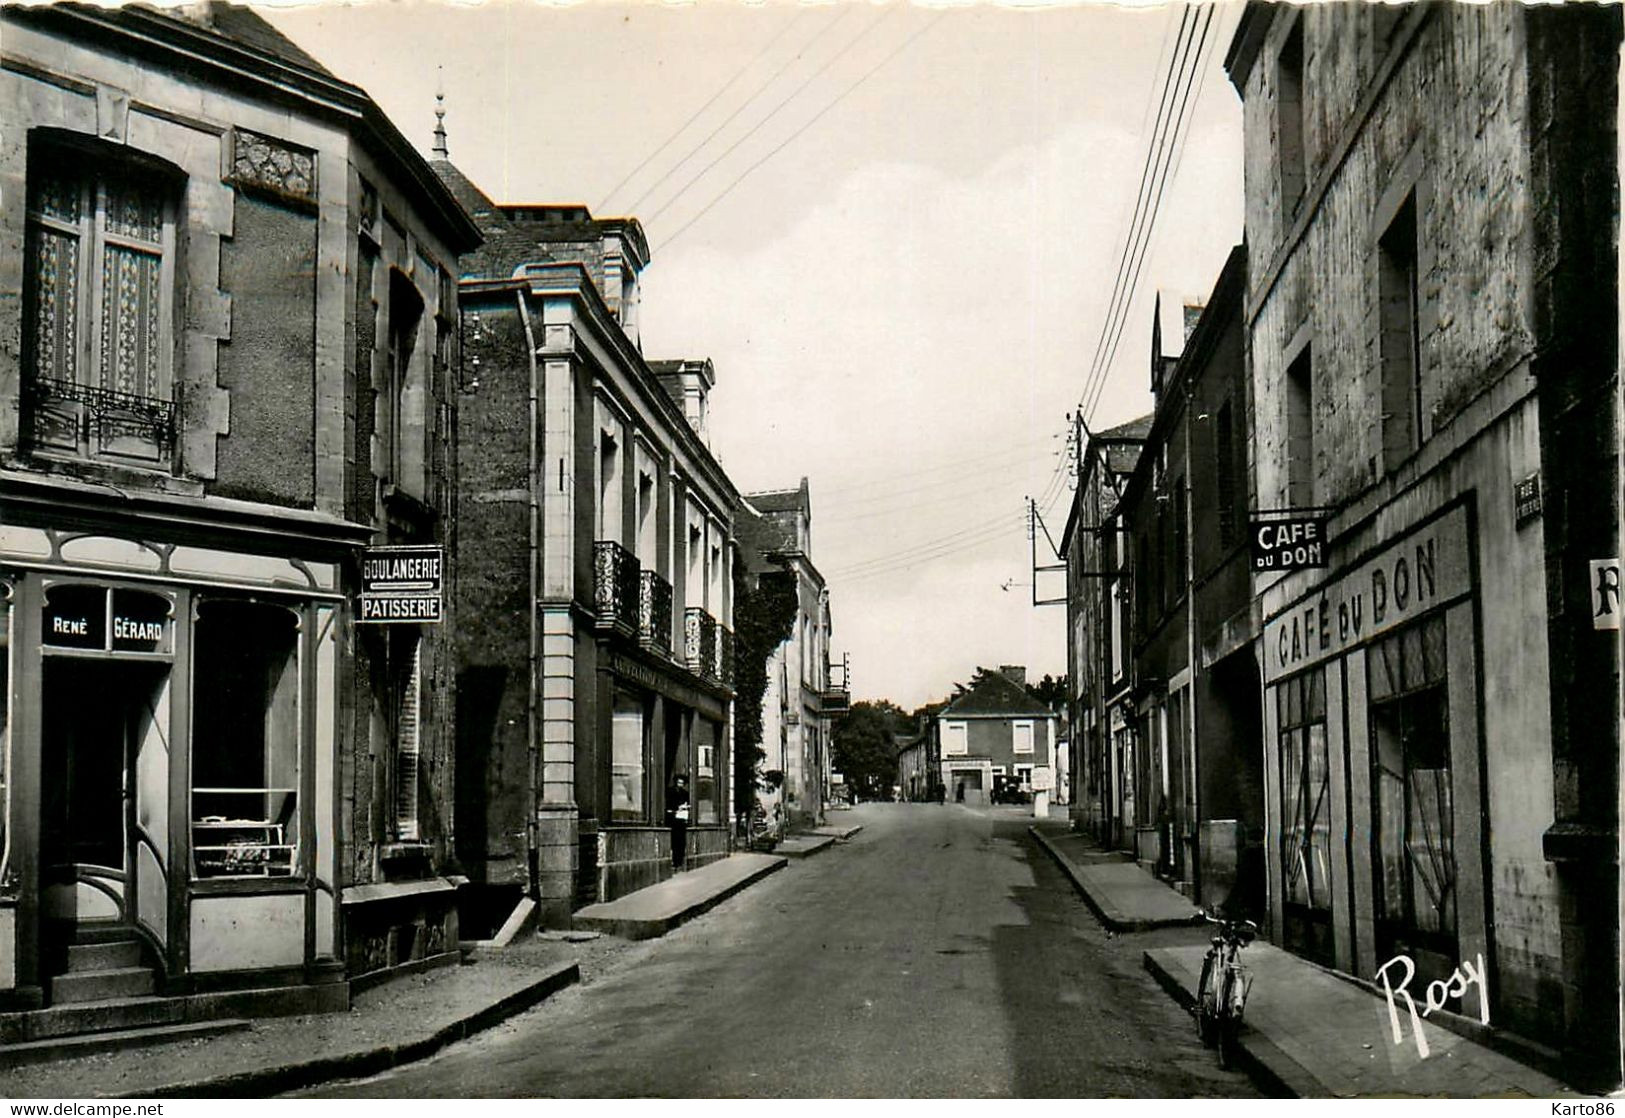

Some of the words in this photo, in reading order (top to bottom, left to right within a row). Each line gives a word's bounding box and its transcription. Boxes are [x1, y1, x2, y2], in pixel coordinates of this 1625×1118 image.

[1257, 555, 1274, 568] DU
[1282, 542, 1322, 566] DON
[364, 558, 440, 580] BOULANGERIE
[1338, 594, 1362, 643] DU
[1372, 538, 1436, 625] DON
[364, 598, 438, 618] PATISSERIE
[114, 617, 162, 640] GÉRARD
